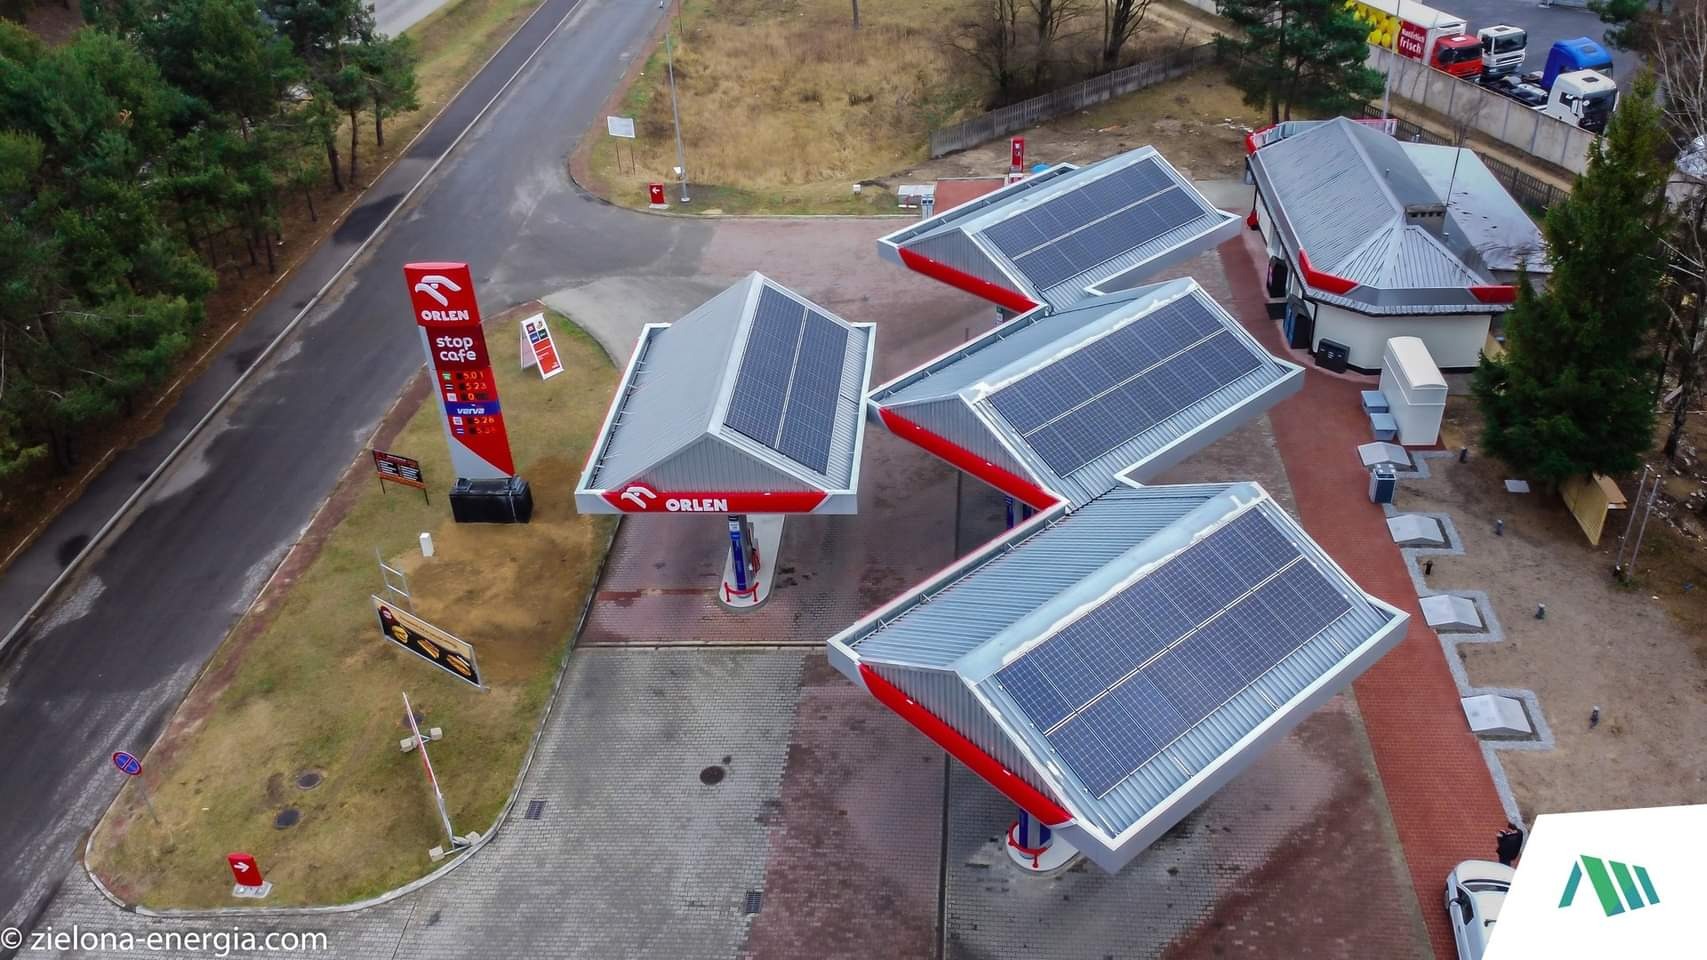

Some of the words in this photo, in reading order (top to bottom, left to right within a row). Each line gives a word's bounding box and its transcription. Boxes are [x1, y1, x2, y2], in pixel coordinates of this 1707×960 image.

[1400, 36, 1421, 54] frisch
[421, 310, 470, 321] ORLEN
[436, 336, 473, 350] stop
[440, 349, 476, 362] cafe
[665, 498, 728, 512] ORLEN
